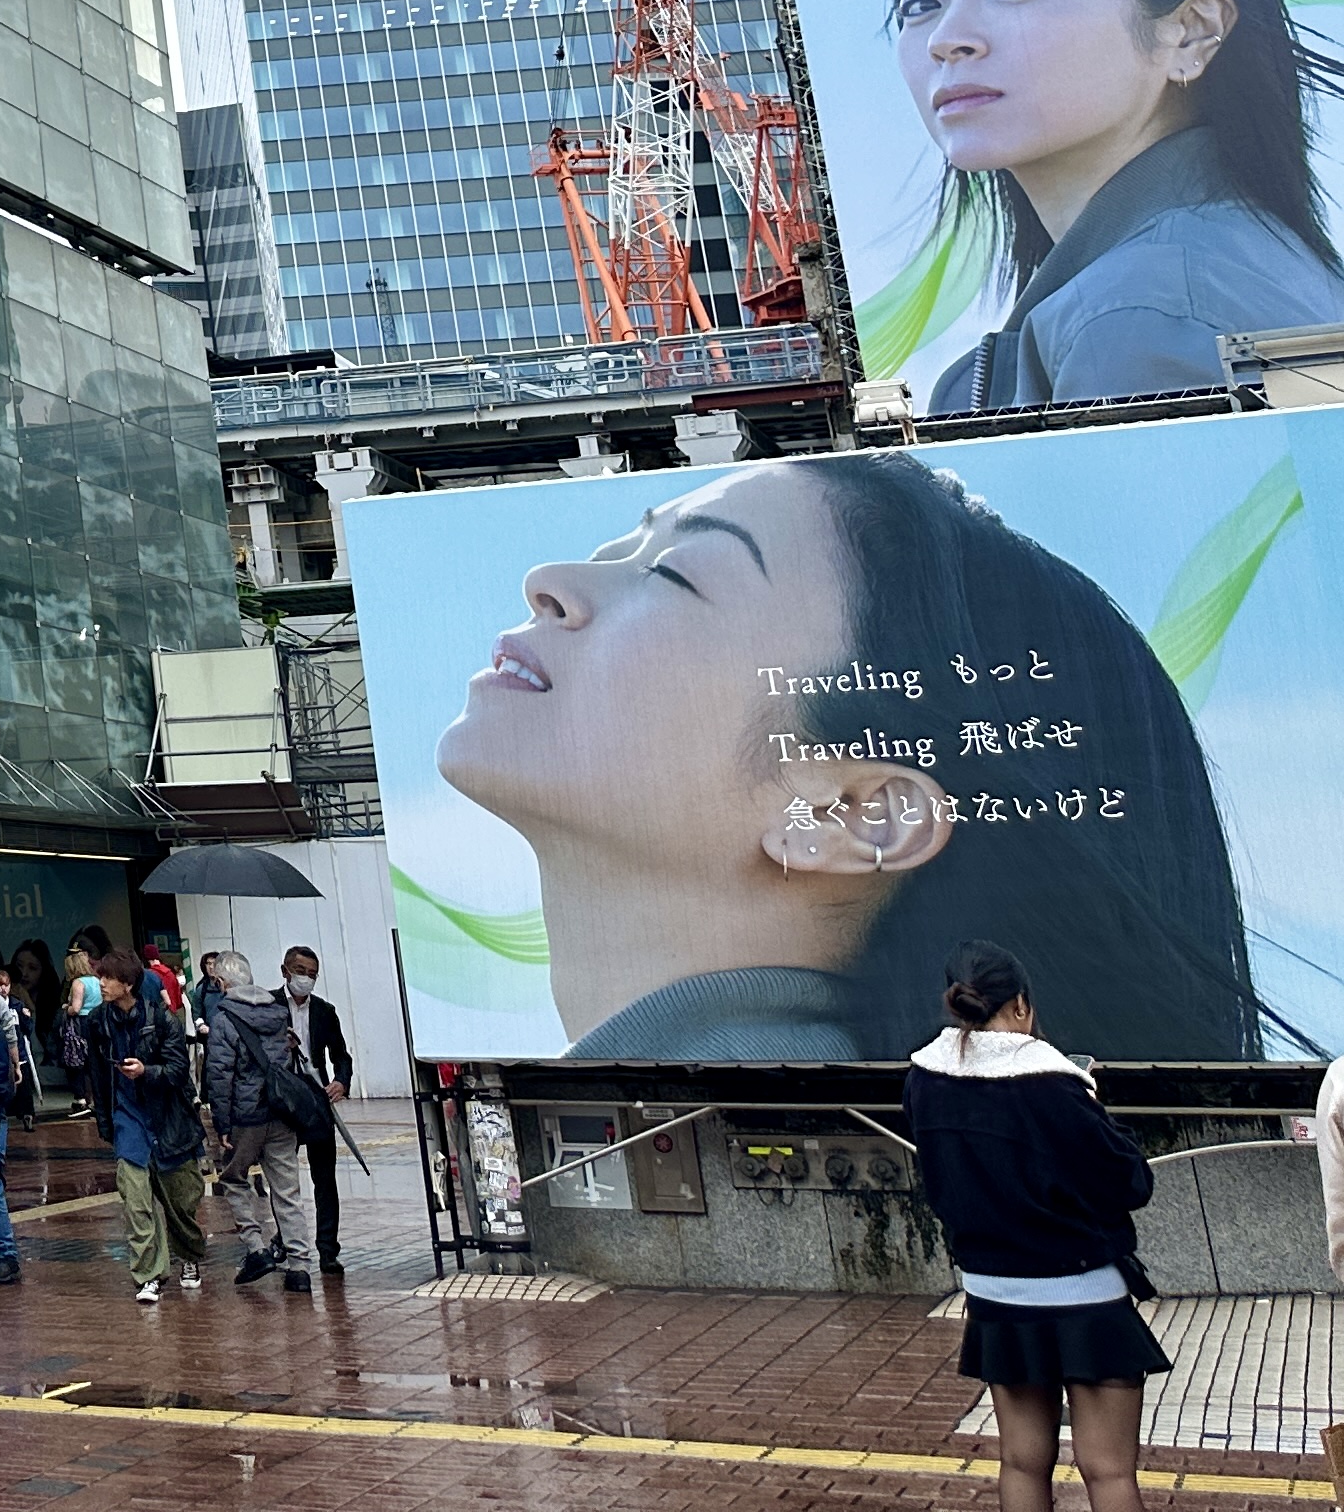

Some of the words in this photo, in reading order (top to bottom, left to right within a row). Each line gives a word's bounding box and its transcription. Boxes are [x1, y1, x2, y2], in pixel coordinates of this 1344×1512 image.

[757, 661, 923, 699] Traveling
[950, 650, 1055, 685] もっと
[768, 729, 937, 768] Traveling
[959, 716, 1083, 757] 飛ばせ
[783, 787, 1126, 832] 急ぐことはないけど
